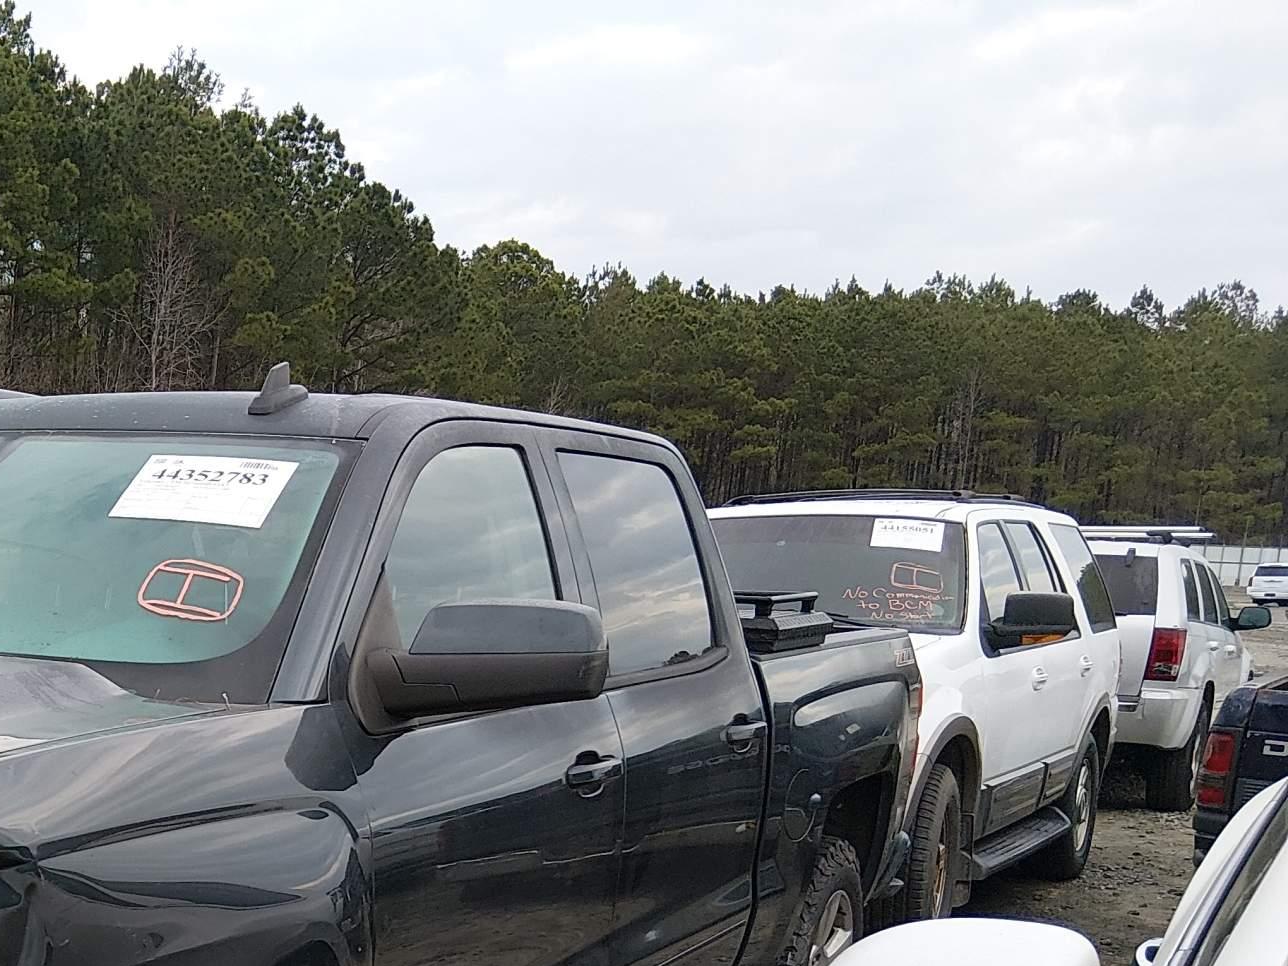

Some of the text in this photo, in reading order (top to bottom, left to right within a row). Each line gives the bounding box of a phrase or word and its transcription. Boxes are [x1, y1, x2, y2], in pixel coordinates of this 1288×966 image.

[151, 468, 269, 486] 44352783
[842, 586, 869, 599] No
[856, 599, 933, 611] to BCM
[870, 611, 894, 620] No
